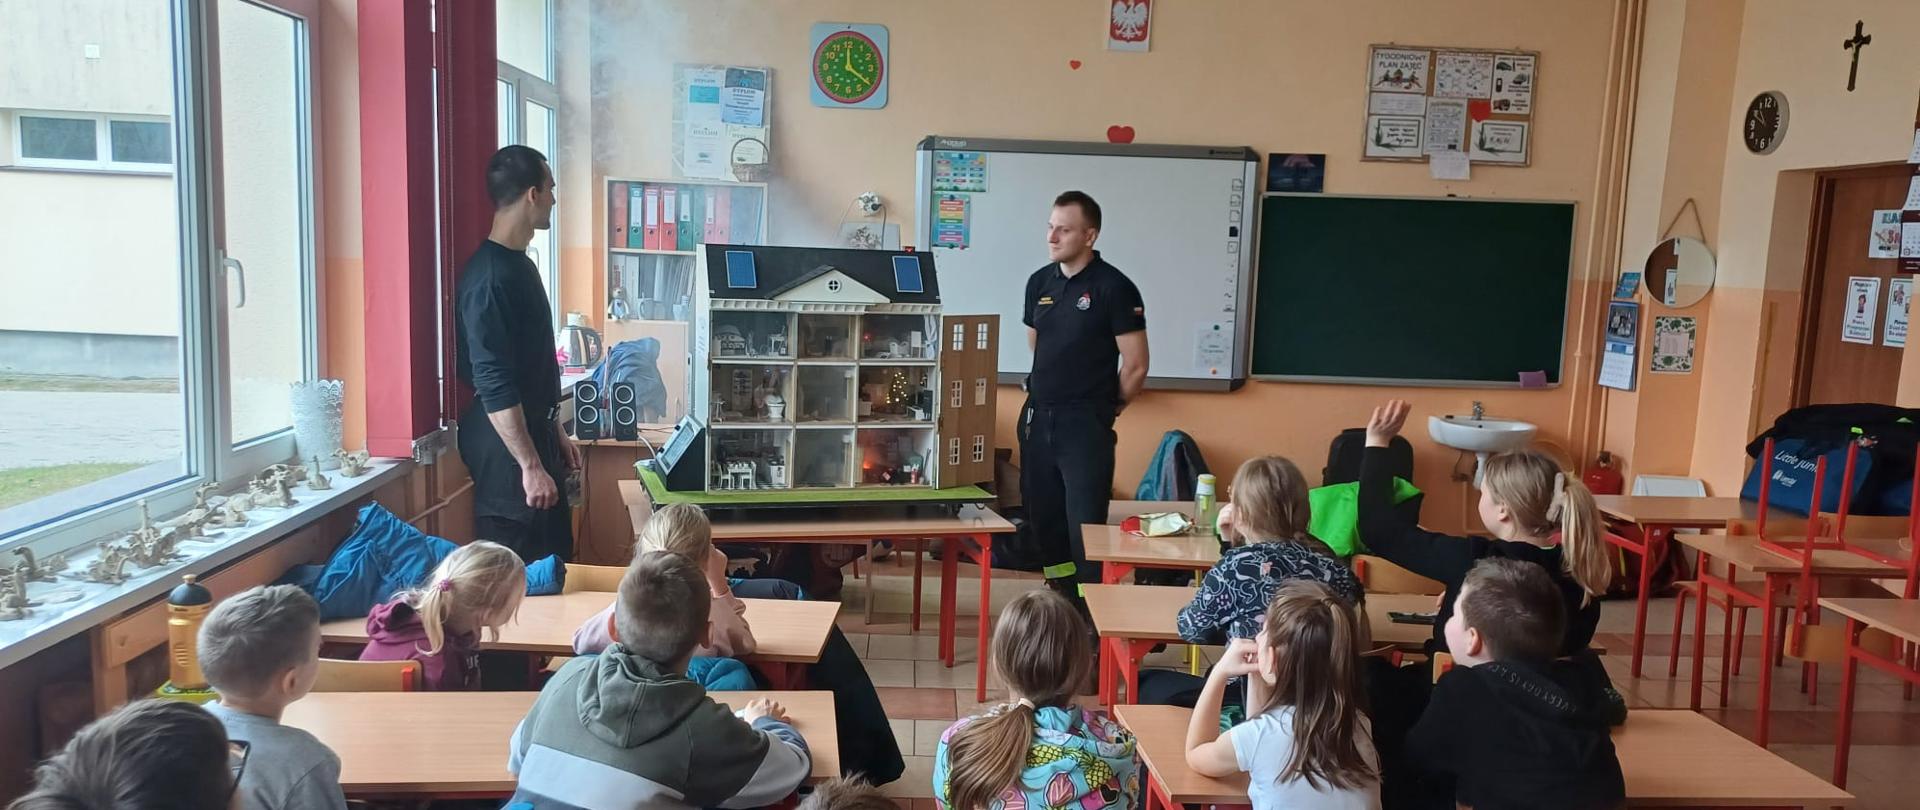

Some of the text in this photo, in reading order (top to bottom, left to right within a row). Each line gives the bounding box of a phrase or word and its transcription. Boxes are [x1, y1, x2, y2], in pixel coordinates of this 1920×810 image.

[832, 44, 841, 52] 11
[844, 41, 853, 49] 12
[865, 53, 872, 61] 2
[1379, 61, 1398, 69] PLAN
[845, 86, 852, 94] 6
[1764, 97, 1773, 108] 12
[1750, 120, 1756, 130] 9
[1760, 138, 1765, 149] 6
[1774, 450, 1799, 464] Little
